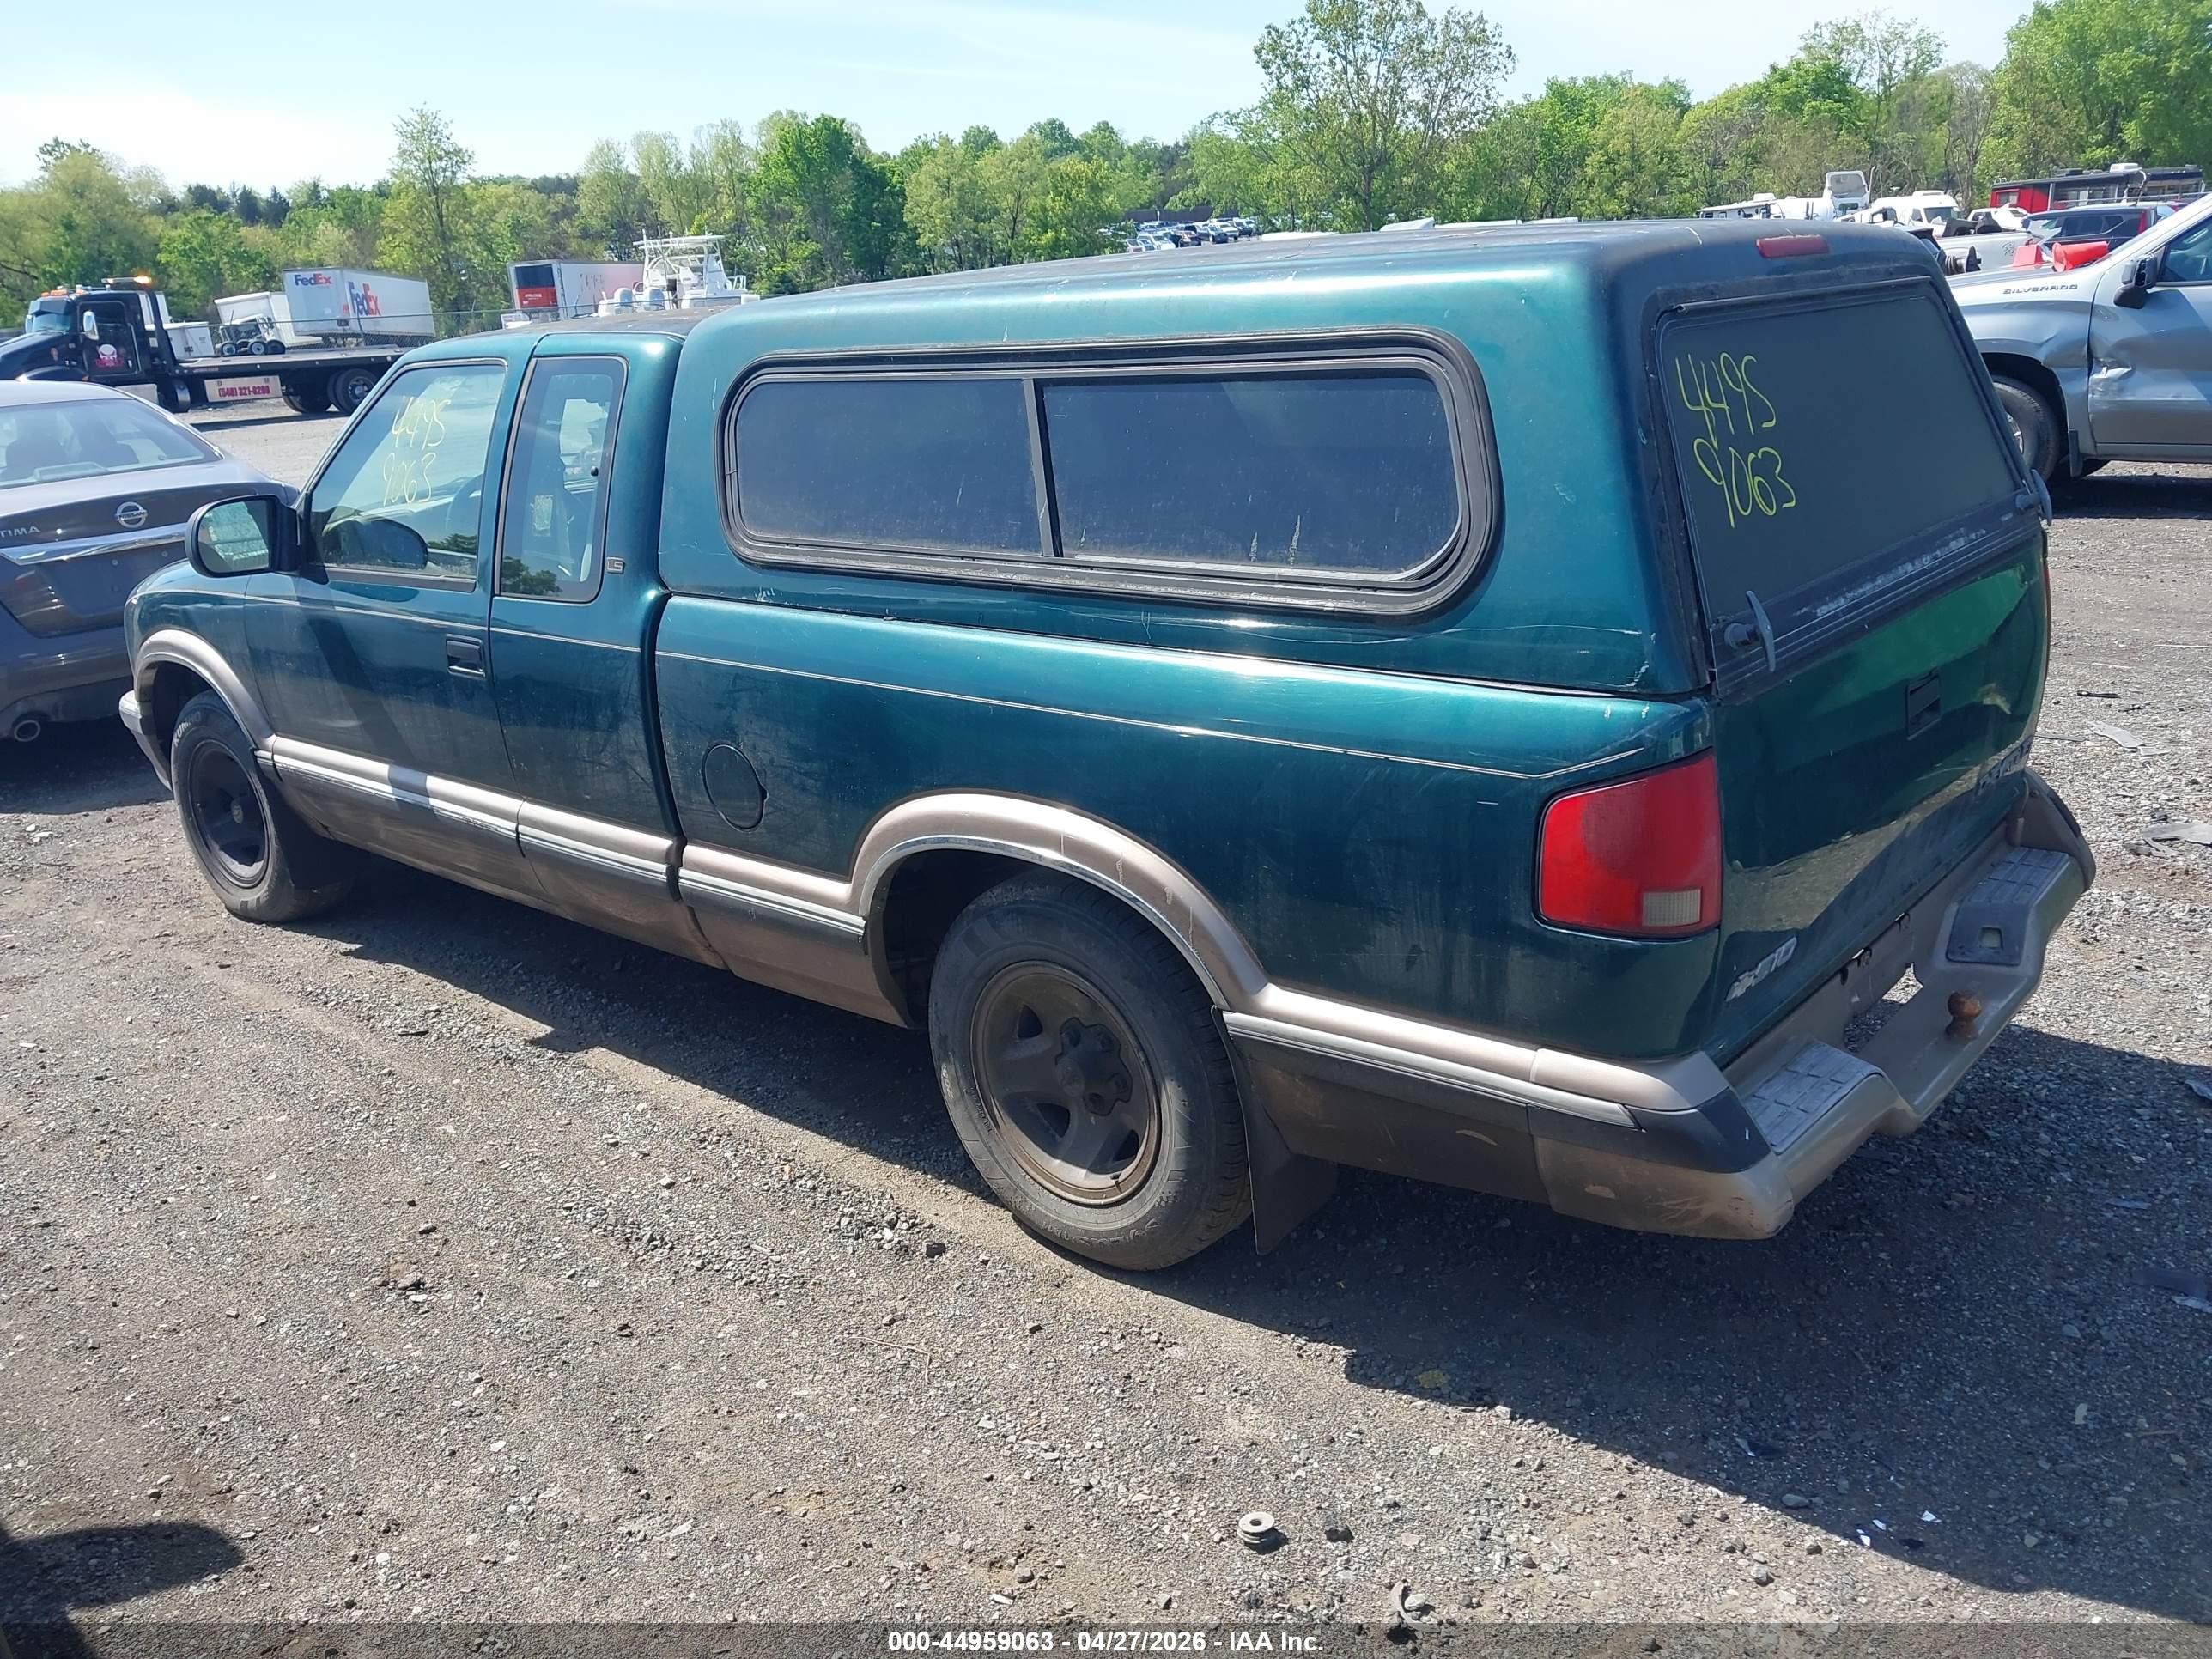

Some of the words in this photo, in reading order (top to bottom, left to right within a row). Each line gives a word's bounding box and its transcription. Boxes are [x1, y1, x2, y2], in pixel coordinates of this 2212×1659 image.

[294, 274, 331, 286] FedEx
[348, 282, 381, 316] FedEx
[2002, 284, 2078, 295] SILVERADO
[392, 395, 452, 451] 4495
[1675, 352, 1777, 450] 4495
[383, 452, 437, 507] 9063
[1693, 438, 1796, 528] 9063
